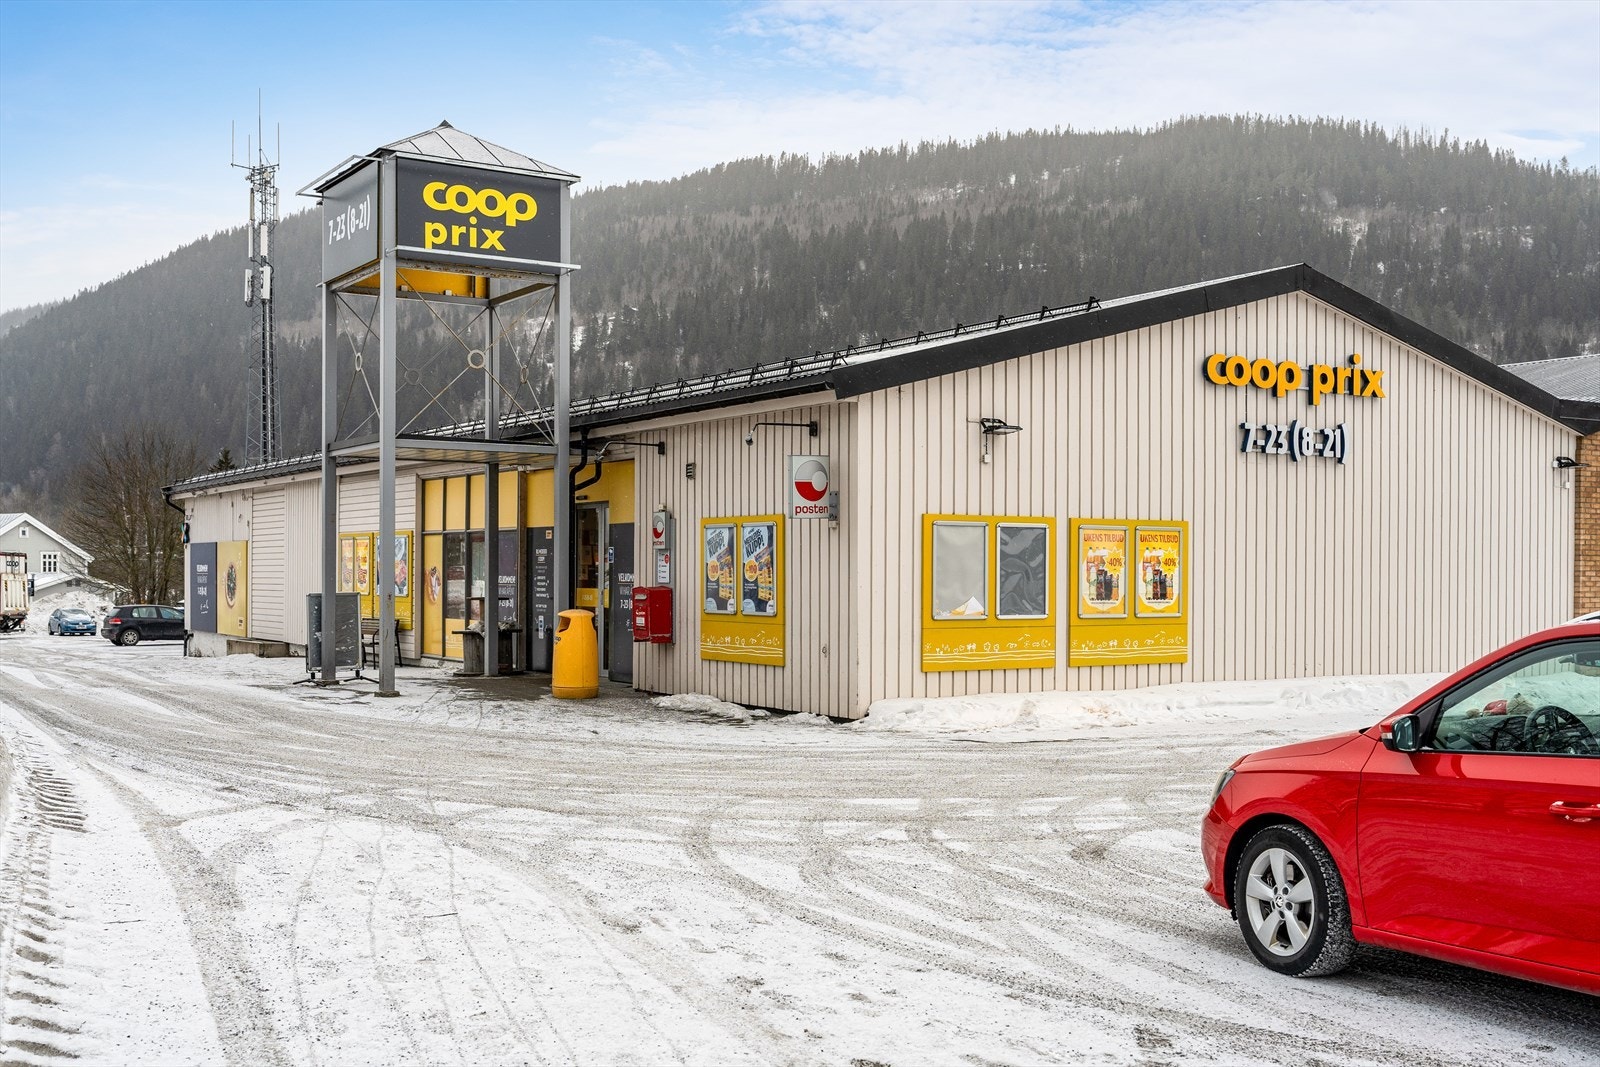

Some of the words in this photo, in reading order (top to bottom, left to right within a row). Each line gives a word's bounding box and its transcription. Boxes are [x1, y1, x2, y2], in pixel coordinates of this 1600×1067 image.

[423, 181, 538, 227] coop
[328, 216, 346, 245] 7-23
[347, 194, 371, 240] (8-21)
[424, 216, 506, 251] prix
[1204, 353, 1303, 398] coop
[1309, 353, 1386, 406] prix
[1239, 421, 1289, 455] 7-23
[1290, 419, 1348, 464] (8-21)
[795, 503, 829, 516] posten
[746, 534, 765, 558] KUPP!
[1083, 533, 1103, 542] UKENS
[1104, 534, 1124, 543] TILBUD
[1140, 534, 1159, 543] UKENS
[1159, 534, 1179, 543] TILBUD
[6, 560, 19, 568] coop
[1107, 557, 1122, 567] -40%
[1162, 557, 1176, 567] -40%
